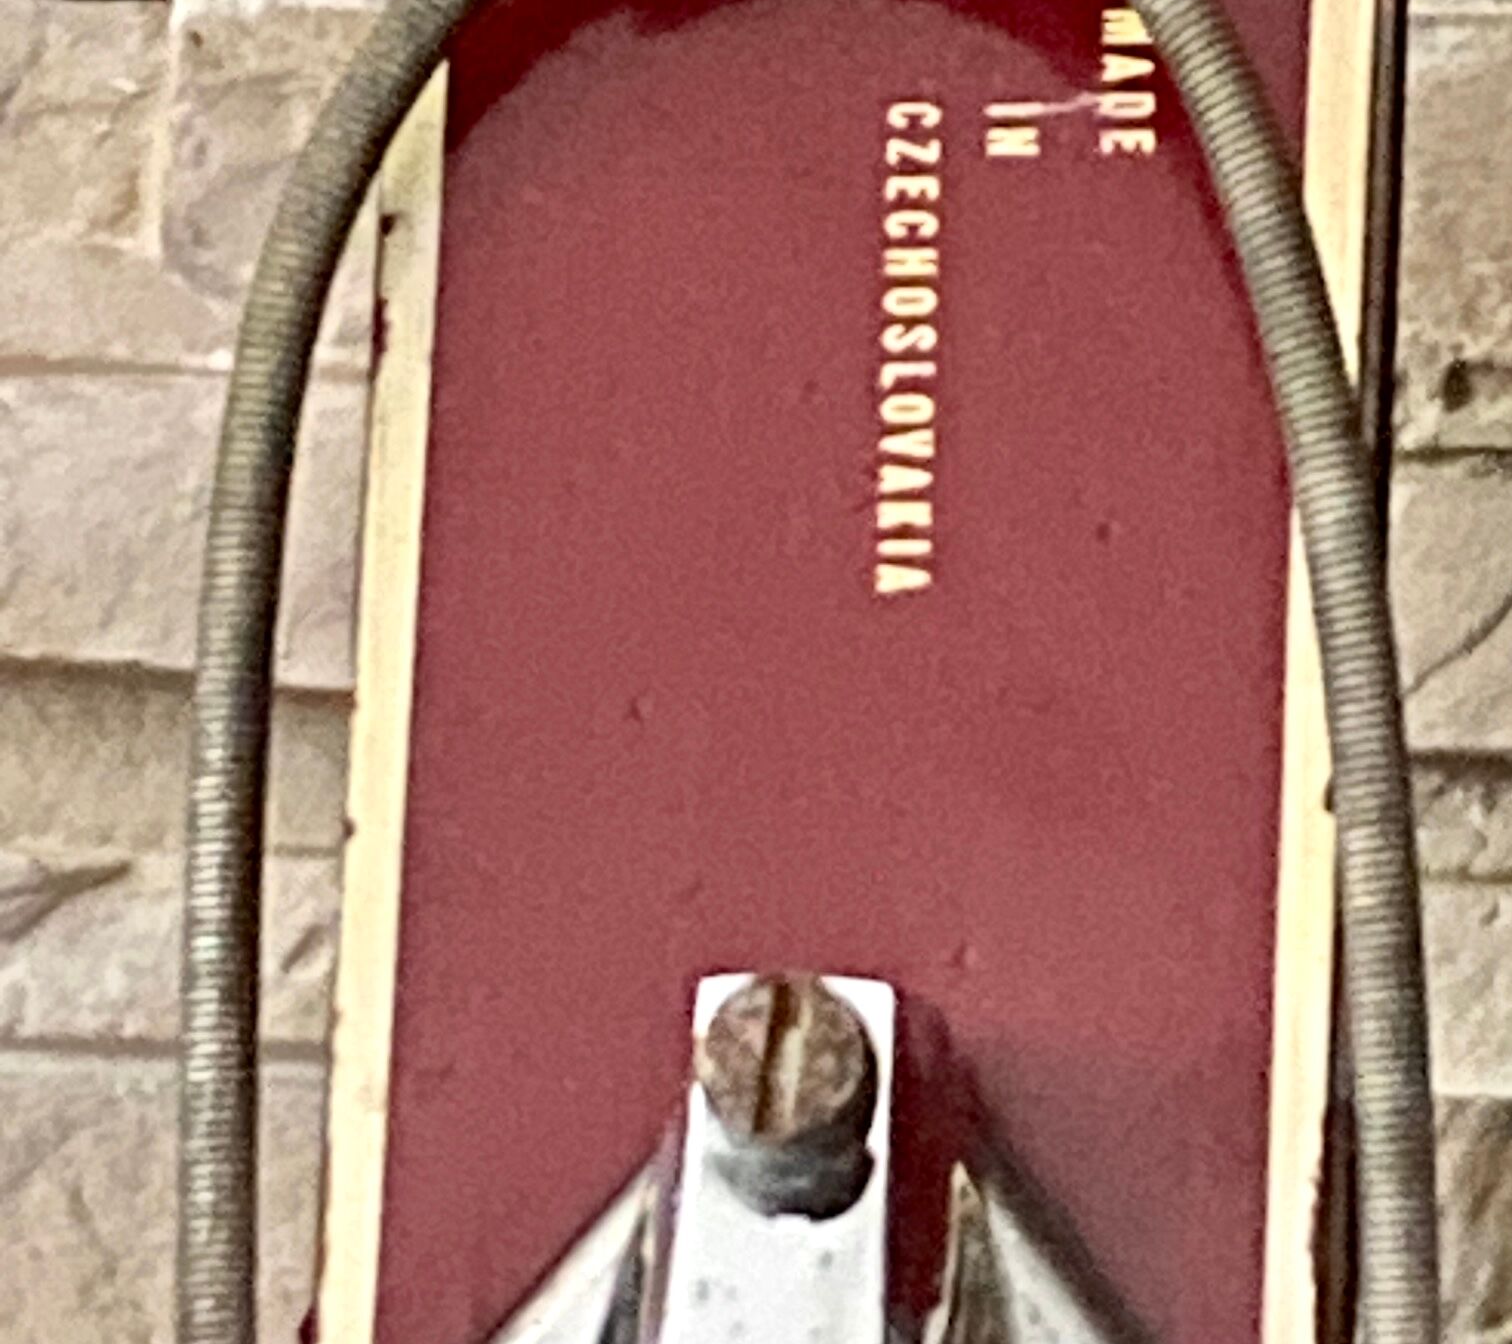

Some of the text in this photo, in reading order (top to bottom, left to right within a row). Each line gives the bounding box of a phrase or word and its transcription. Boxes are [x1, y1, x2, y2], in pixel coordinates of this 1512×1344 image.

[985, 102, 1040, 157] IN
[1098, 8, 1156, 155] MADE
[876, 101, 941, 594] CZECHOSLOVAKIA
